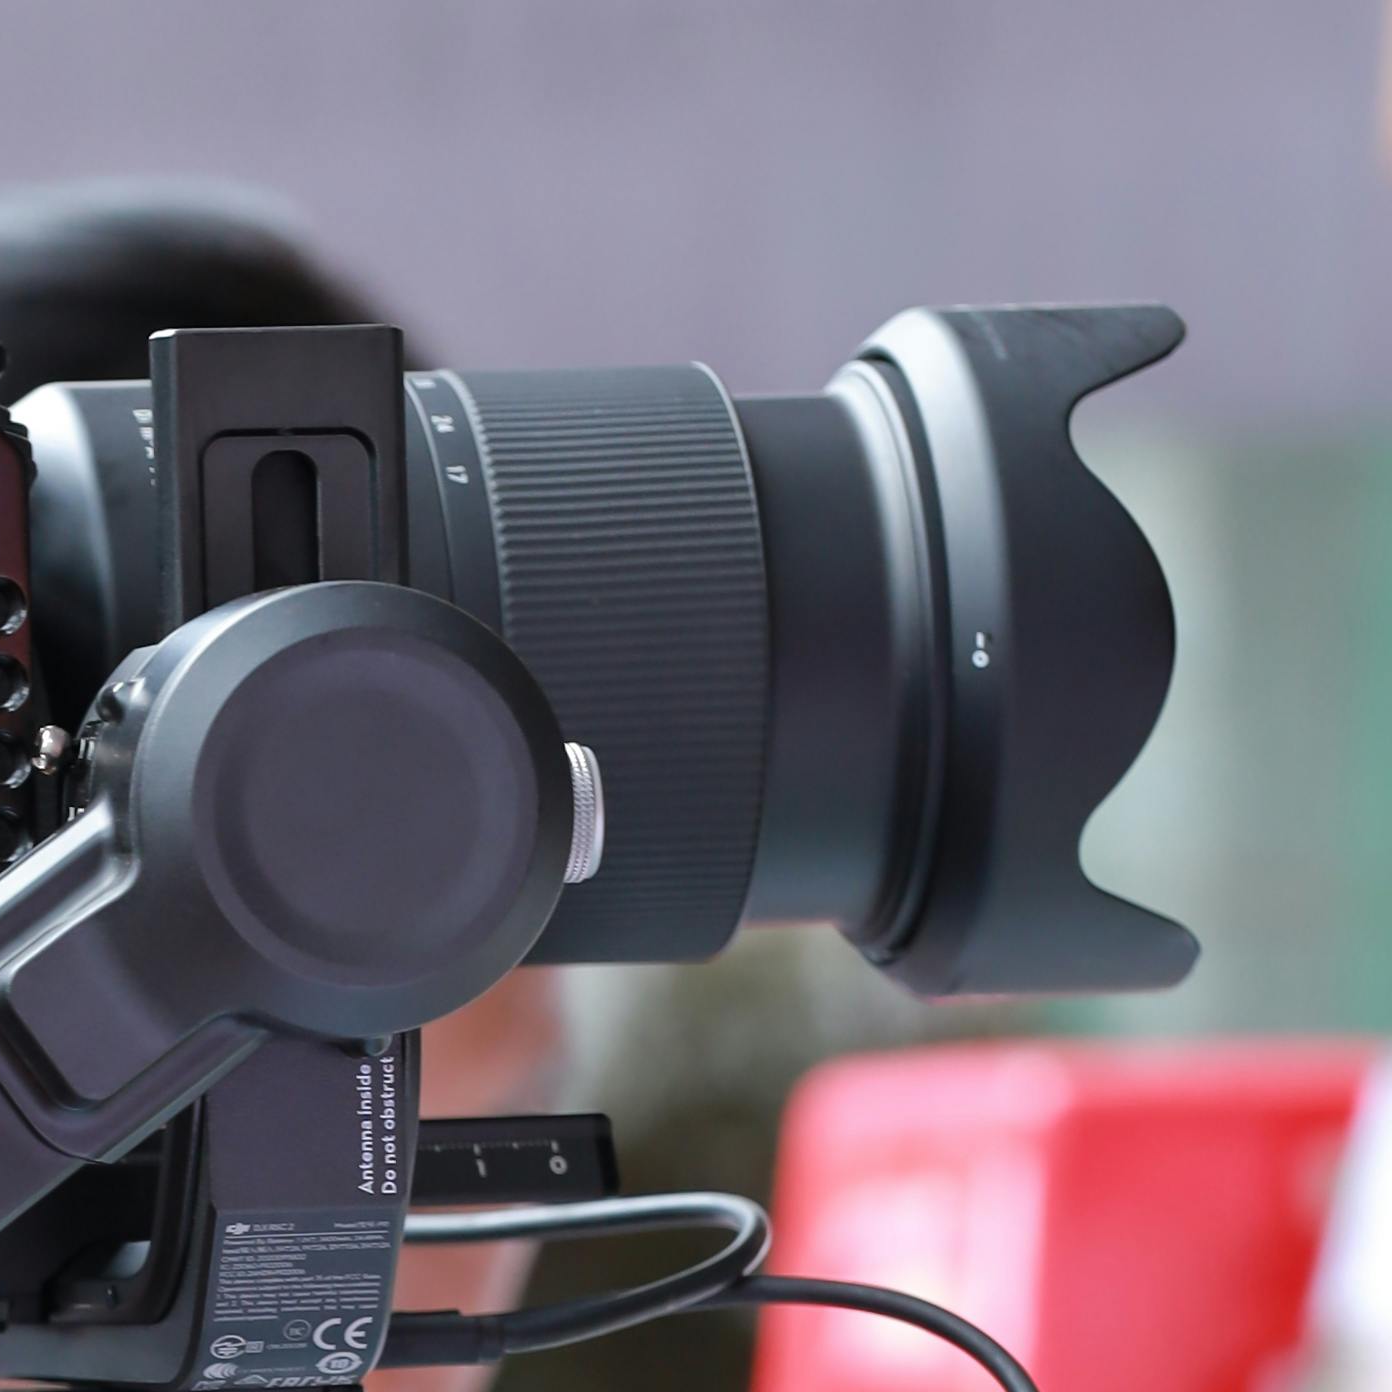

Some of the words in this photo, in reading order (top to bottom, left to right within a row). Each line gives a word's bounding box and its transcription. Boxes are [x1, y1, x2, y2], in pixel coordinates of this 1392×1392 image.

[446, 465, 468, 484] 17
[379, 1056, 396, 1130] obstruct
[357, 1121, 375, 1194] Antenna
[381, 1135, 397, 1164] not
[381, 1168, 397, 1194] Do
[312, 1316, 374, 1350] CE
